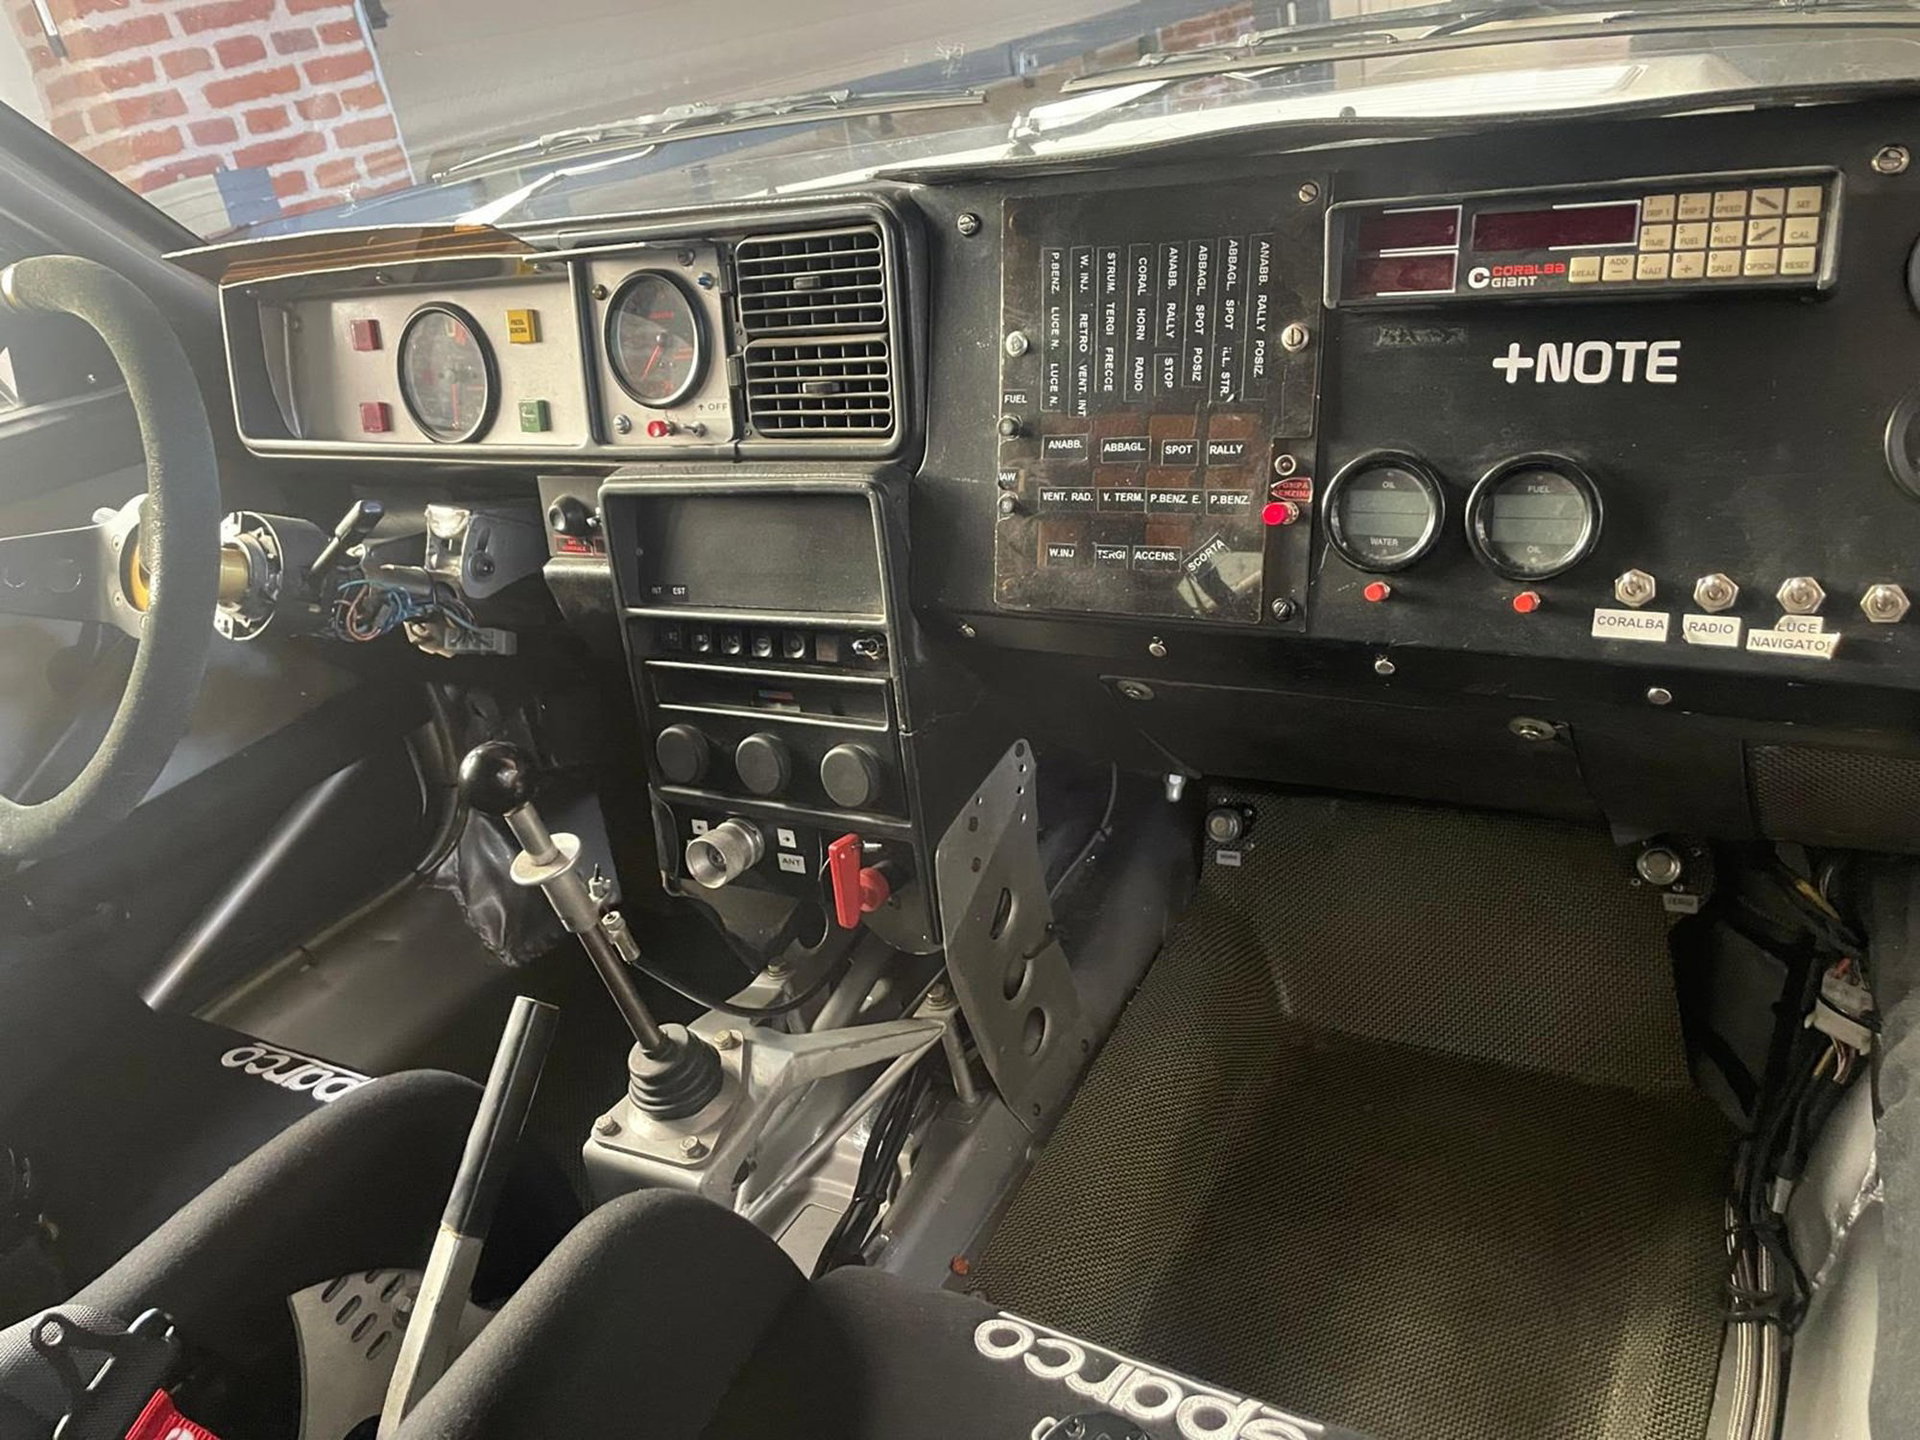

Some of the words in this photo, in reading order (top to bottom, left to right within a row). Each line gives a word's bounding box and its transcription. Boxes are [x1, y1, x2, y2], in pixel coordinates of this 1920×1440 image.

[1680, 237, 1698, 245] FUEL
[1791, 231, 1809, 240] CAL
[1784, 261, 1810, 269] RESET
[1137, 257, 1148, 296] CORAL
[1105, 303, 1115, 336] TERGI
[1166, 302, 1176, 339] RALLY
[1195, 304, 1205, 335] SPOT
[1225, 299, 1236, 330] SPOT
[1256, 294, 1268, 333] RALLY
[1050, 306, 1060, 336] LUCE
[1136, 308, 1146, 341] HORN
[1079, 313, 1089, 352] RETRO
[1103, 347, 1114, 392] FRECCE
[1134, 357, 1144, 392] RADIO
[1164, 357, 1174, 389] STOP
[1050, 363, 1059, 392] LUCE
[1077, 364, 1088, 396] VENT.
[1004, 394, 1028, 404] FUEL
[707, 403, 728, 411] OFF
[1077, 399, 1087, 417] INT
[1048, 439, 1083, 449] ANABB.
[1165, 444, 1193, 454] SPOT
[1209, 444, 1244, 455] RALLY
[1382, 480, 1396, 489] OIL
[1528, 485, 1551, 493] FUEL
[1042, 492, 1068, 501] VENT.
[1071, 492, 1094, 501] RAD.
[1115, 492, 1144, 502] TERM.
[1370, 537, 1399, 547] WATER
[1049, 548, 1075, 558] W.INJ
[1134, 551, 1177, 561] ACCENS.
[1187, 539, 1226, 572] SCORTA
[672, 587, 686, 595] EST
[1597, 615, 1665, 630] CORALBA
[1688, 621, 1734, 634] RADIO
[1777, 622, 1818, 634] LUCE
[1750, 636, 1832, 652] NAVIGATO
[782, 857, 802, 867] ANT
[221, 1046, 378, 1103] parco
